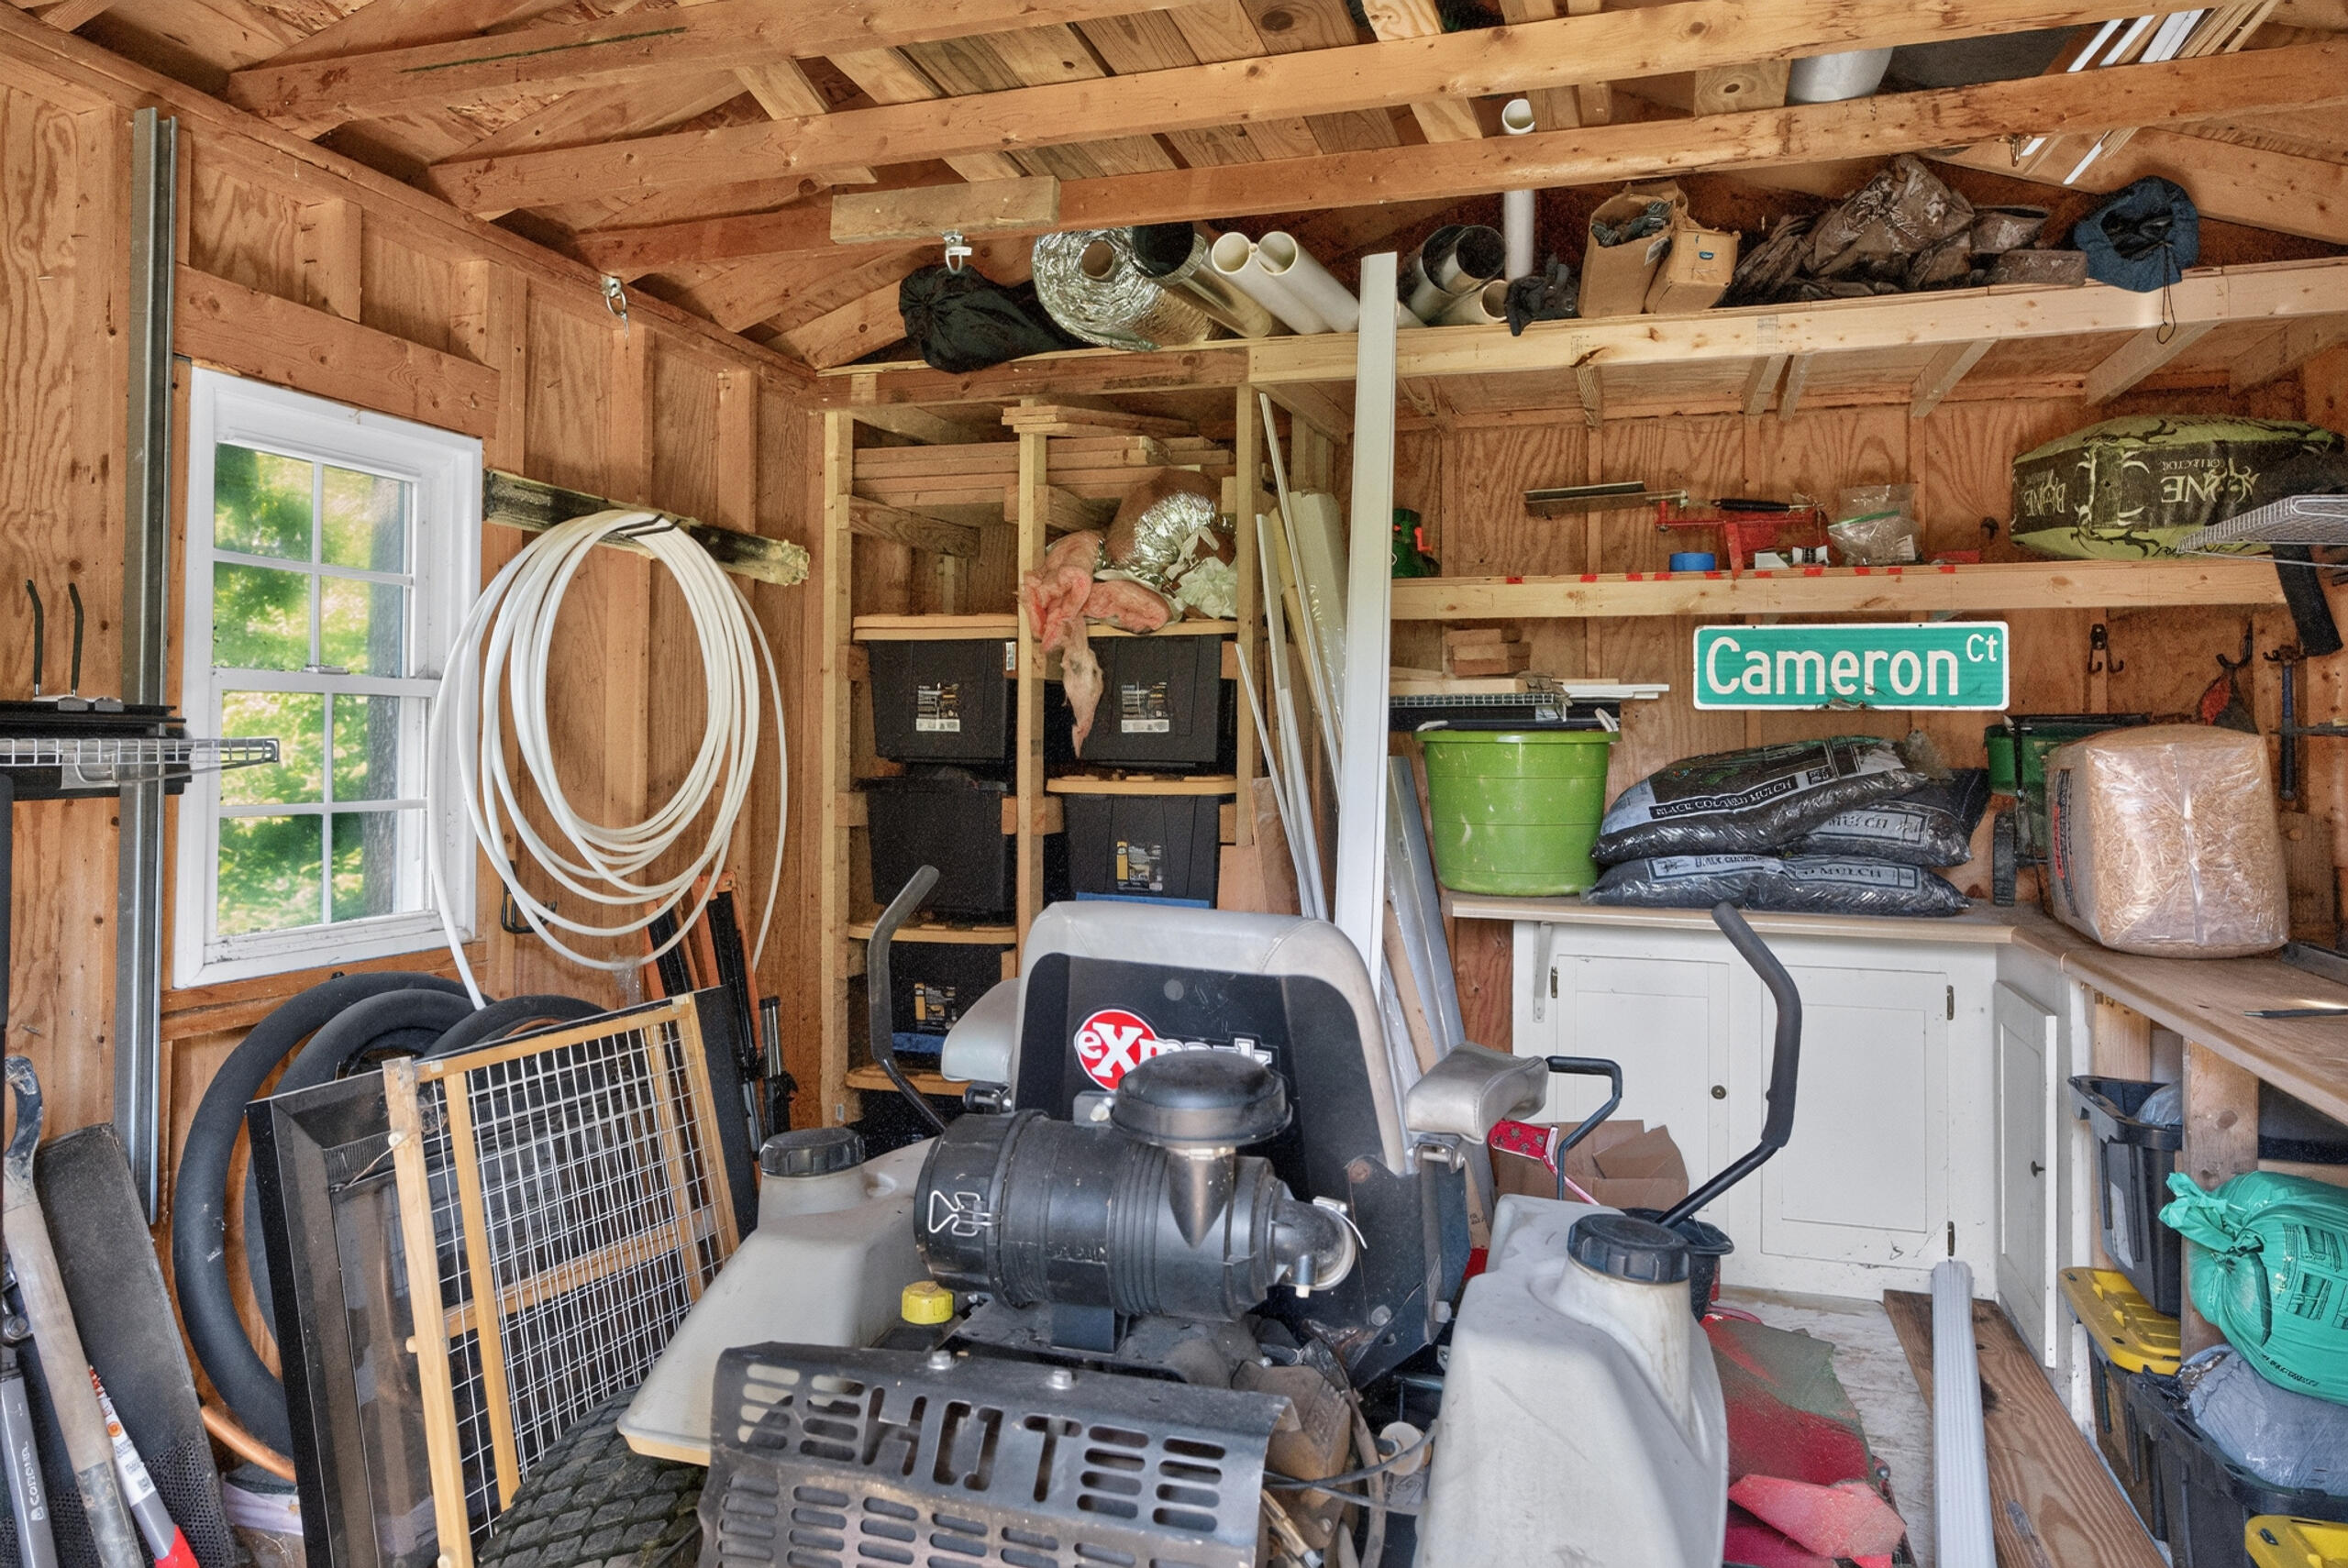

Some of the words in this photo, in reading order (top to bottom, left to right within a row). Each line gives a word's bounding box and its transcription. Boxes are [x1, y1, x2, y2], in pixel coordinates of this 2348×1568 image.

[1706, 636, 1958, 696] Cameron
[1966, 634, 1999, 662] Ct
[1656, 803, 1693, 815] BLACK
[1750, 779, 1792, 802] MULCH
[861, 1385, 1082, 1503] HOT
